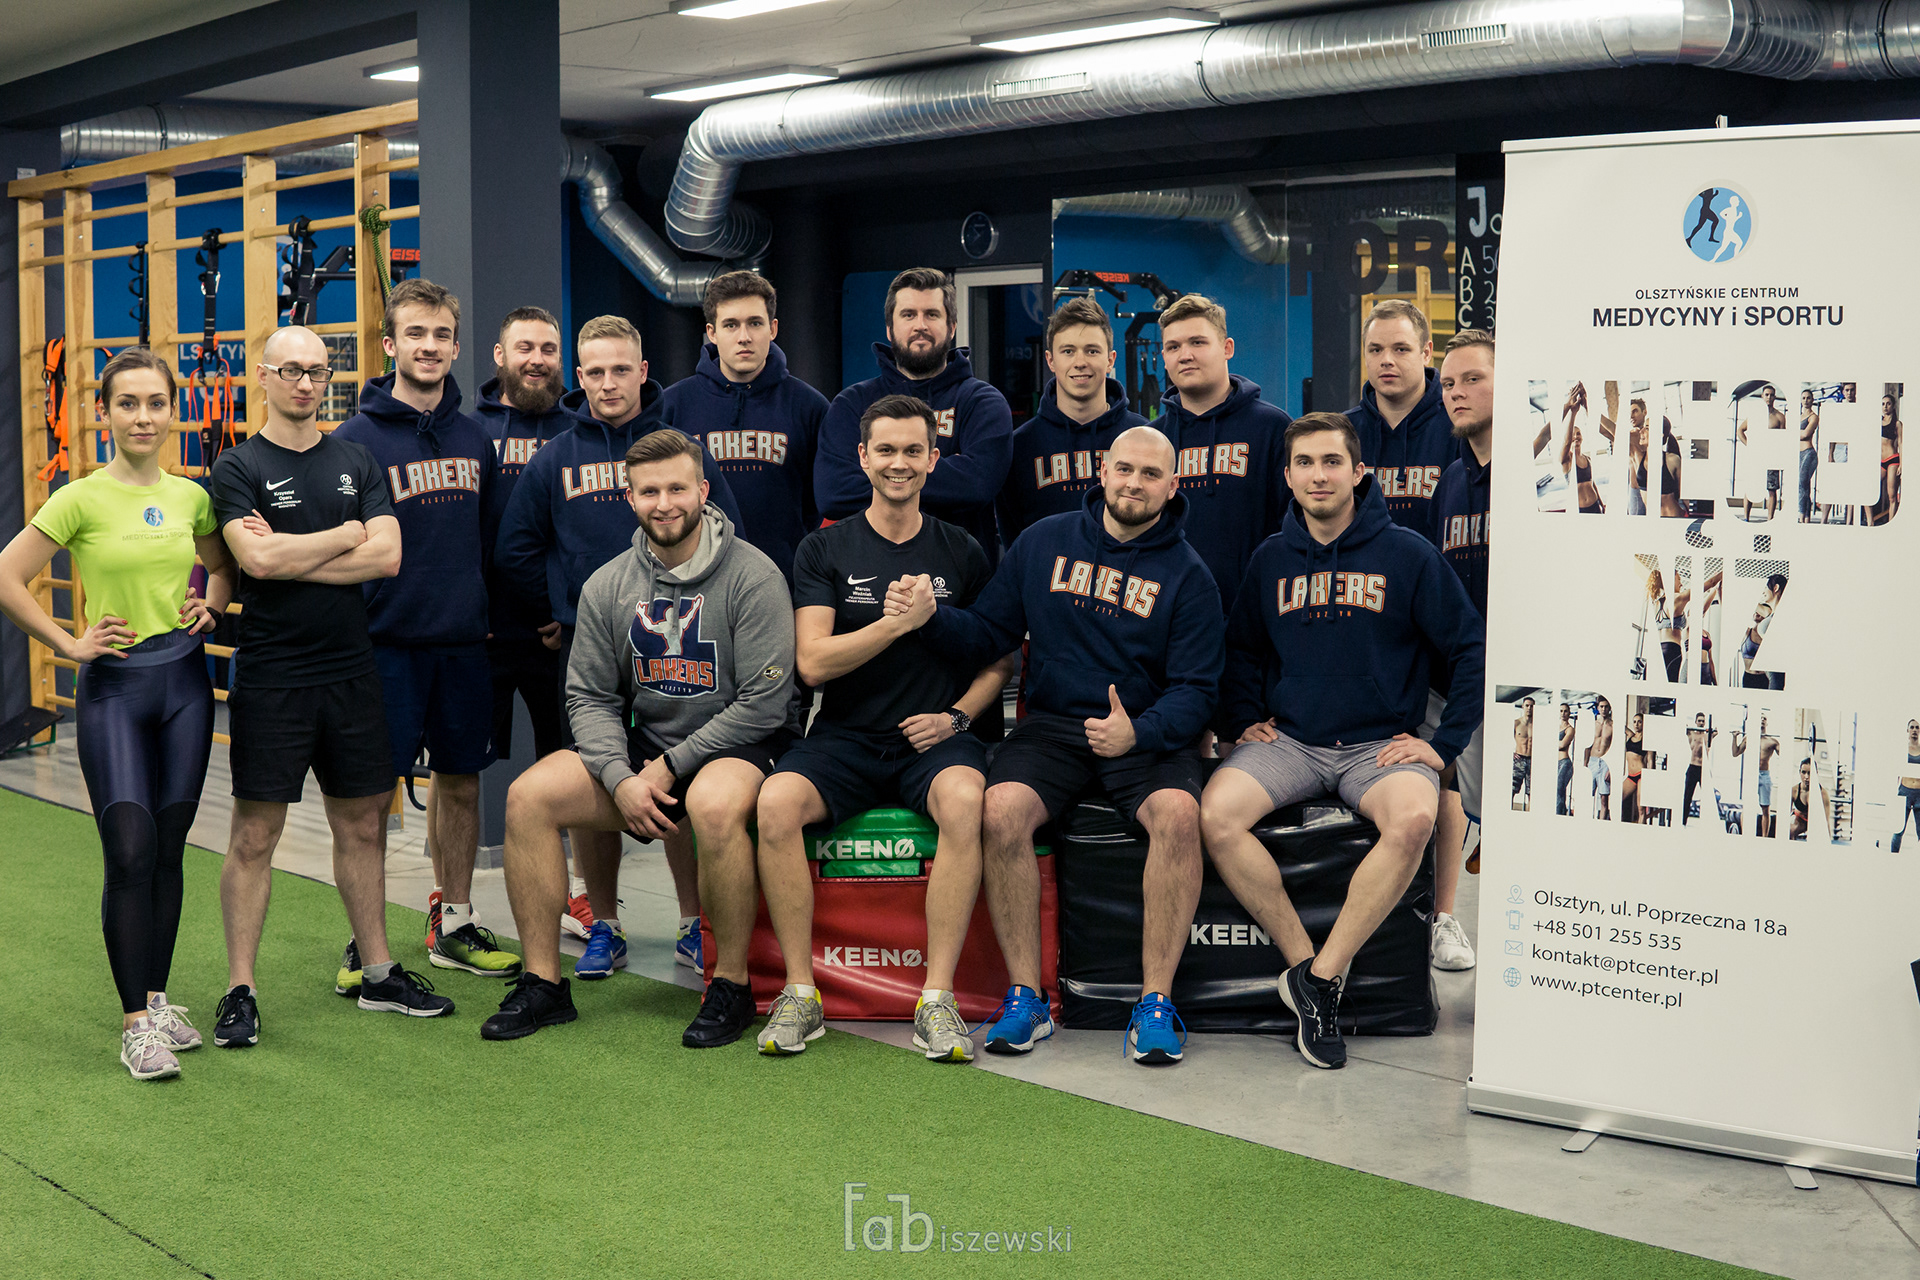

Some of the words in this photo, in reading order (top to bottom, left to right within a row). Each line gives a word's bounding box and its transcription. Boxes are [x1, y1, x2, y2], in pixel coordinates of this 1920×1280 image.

[1460, 246, 1476, 275] A
[1460, 275, 1474, 305] B
[1635, 285, 1726, 300] OLSZTYŃSKIE
[1731, 287, 1799, 299] CENTRUM
[1458, 304, 1473, 328] C
[1593, 306, 1725, 327] MEDYCYNY
[1732, 306, 1737, 326] i
[1744, 305, 1844, 326] SPORTU
[693, 429, 789, 466] AKERS
[388, 457, 480, 503] LAKERS
[562, 460, 629, 502] LAKE
[1050, 555, 1161, 619] LAKERS
[1277, 572, 1387, 617] LAKERS
[635, 657, 714, 688] LAKERS
[1534, 890, 1605, 915] Olsztyn,
[1610, 901, 1632, 917] ul.
[1637, 903, 1746, 931] Poprzeczna
[1754, 918, 1787, 936] 18a
[1533, 919, 1566, 935] +48
[1571, 923, 1601, 940] 501
[1609, 928, 1642, 946] 255
[1648, 933, 1682, 951] 535
[1532, 943, 1719, 986] kontakt@ptcenter.pl
[1530, 974, 1682, 1009] www.ptcenter.pl
